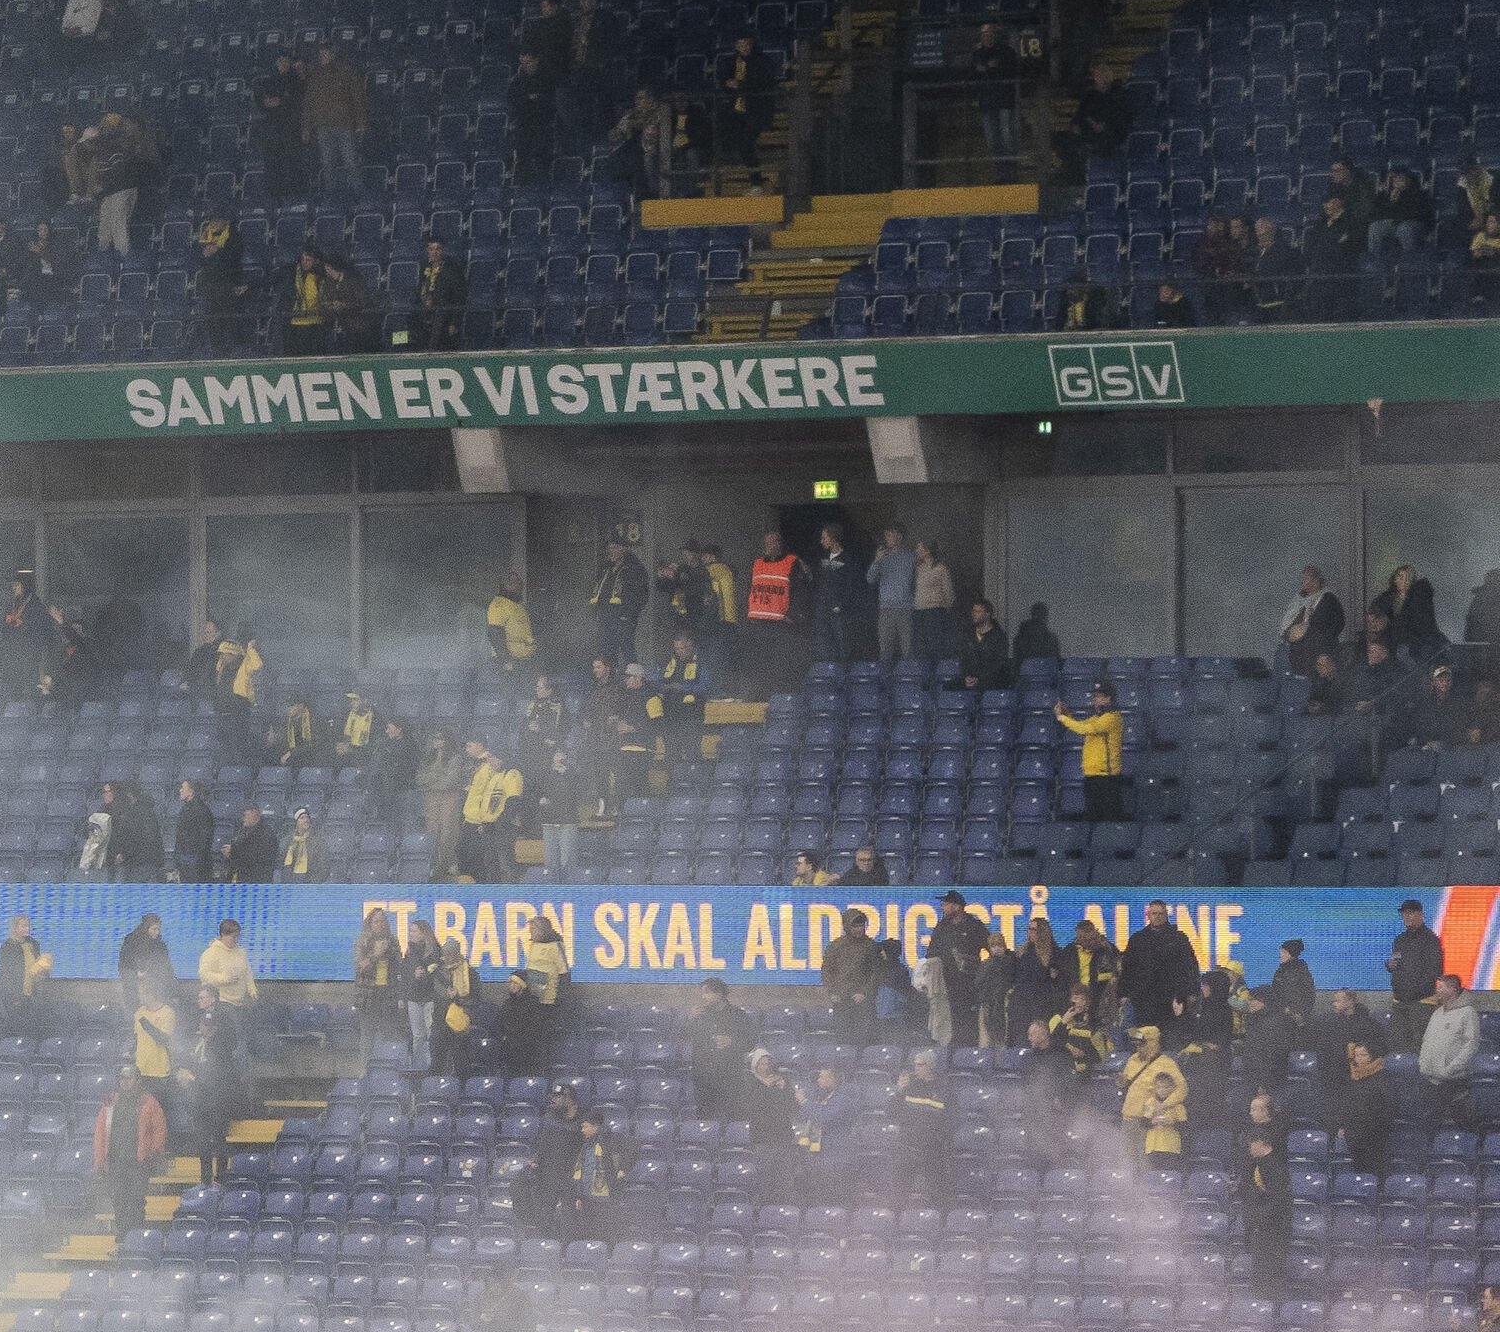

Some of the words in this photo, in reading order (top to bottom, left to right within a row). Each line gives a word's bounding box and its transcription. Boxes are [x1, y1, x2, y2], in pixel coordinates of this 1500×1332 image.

[125, 371, 382, 429] SAMMEN
[389, 368, 470, 420] ER
[475, 365, 540, 415] VI
[547, 355, 885, 414] STÆRKERE
[1058, 363, 1173, 398] GSV
[594, 901, 726, 970] SKAL
